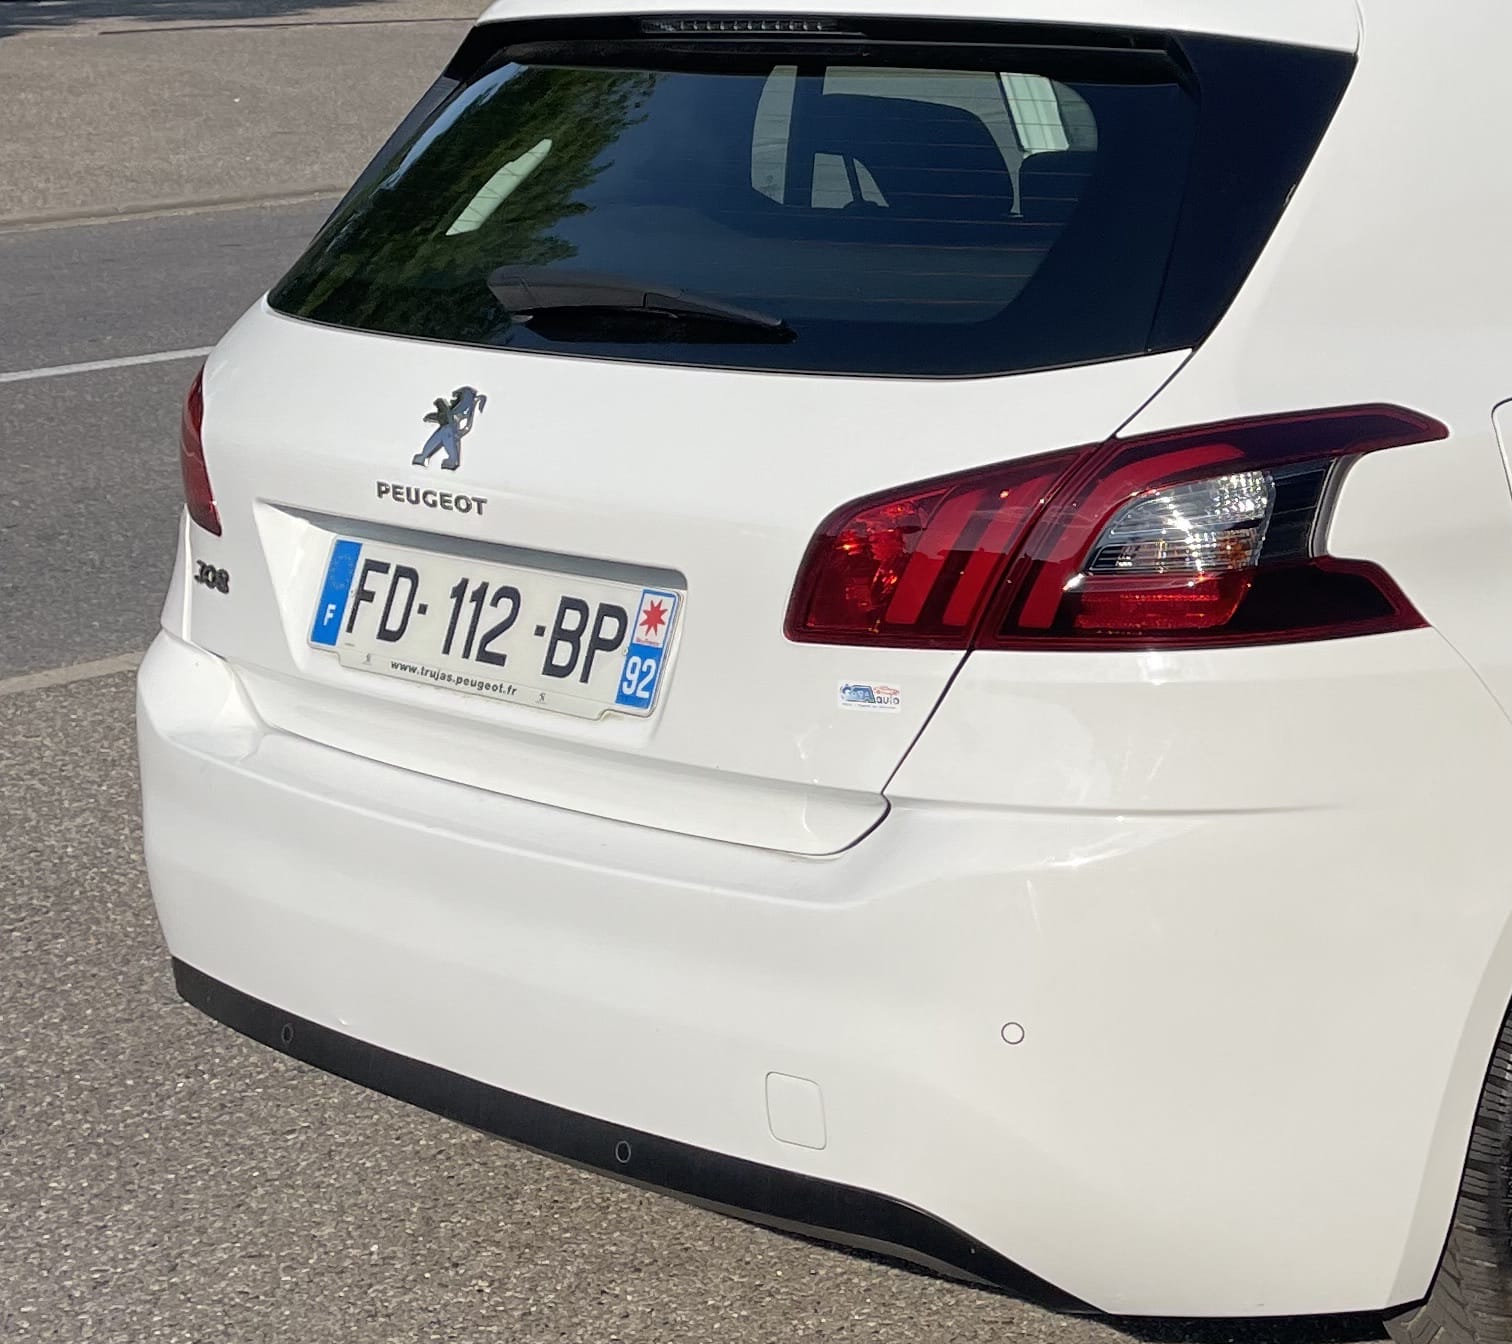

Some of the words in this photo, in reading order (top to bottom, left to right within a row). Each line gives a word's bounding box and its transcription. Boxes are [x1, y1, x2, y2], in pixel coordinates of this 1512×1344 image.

[376, 480, 488, 515] PEUGEOT
[194, 559, 229, 594] 308
[323, 603, 337, 626] F
[390, 659, 518, 696] www.trujas.peugeot.fr
[621, 655, 657, 699] 92
